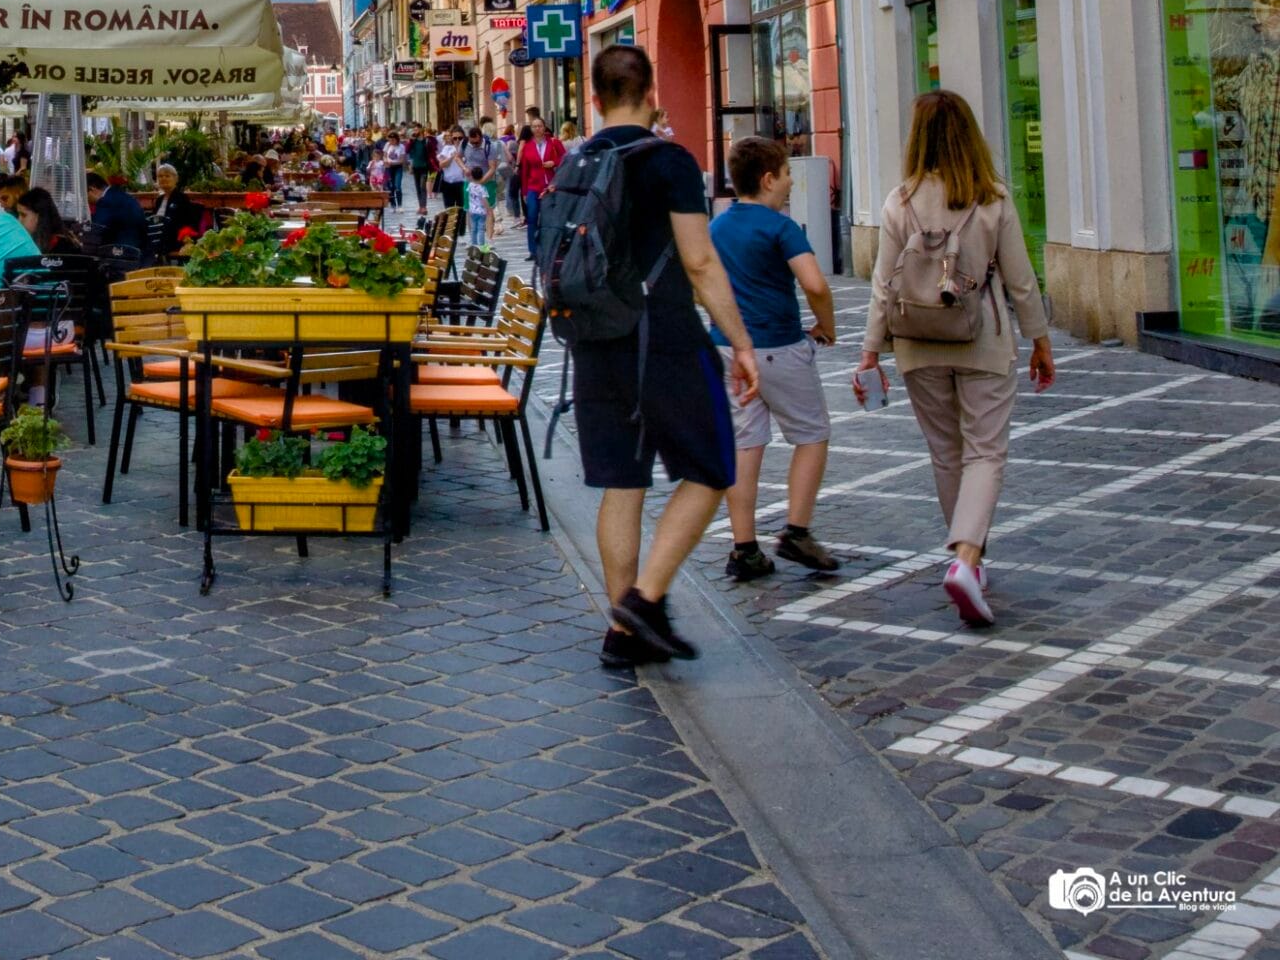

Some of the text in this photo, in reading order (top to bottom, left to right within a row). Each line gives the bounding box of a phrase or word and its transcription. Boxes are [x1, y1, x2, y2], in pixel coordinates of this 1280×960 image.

[22, 4, 52, 29] ÎN
[63, 4, 219, 31] ROMÂNIA.
[441, 32, 468, 46] dm
